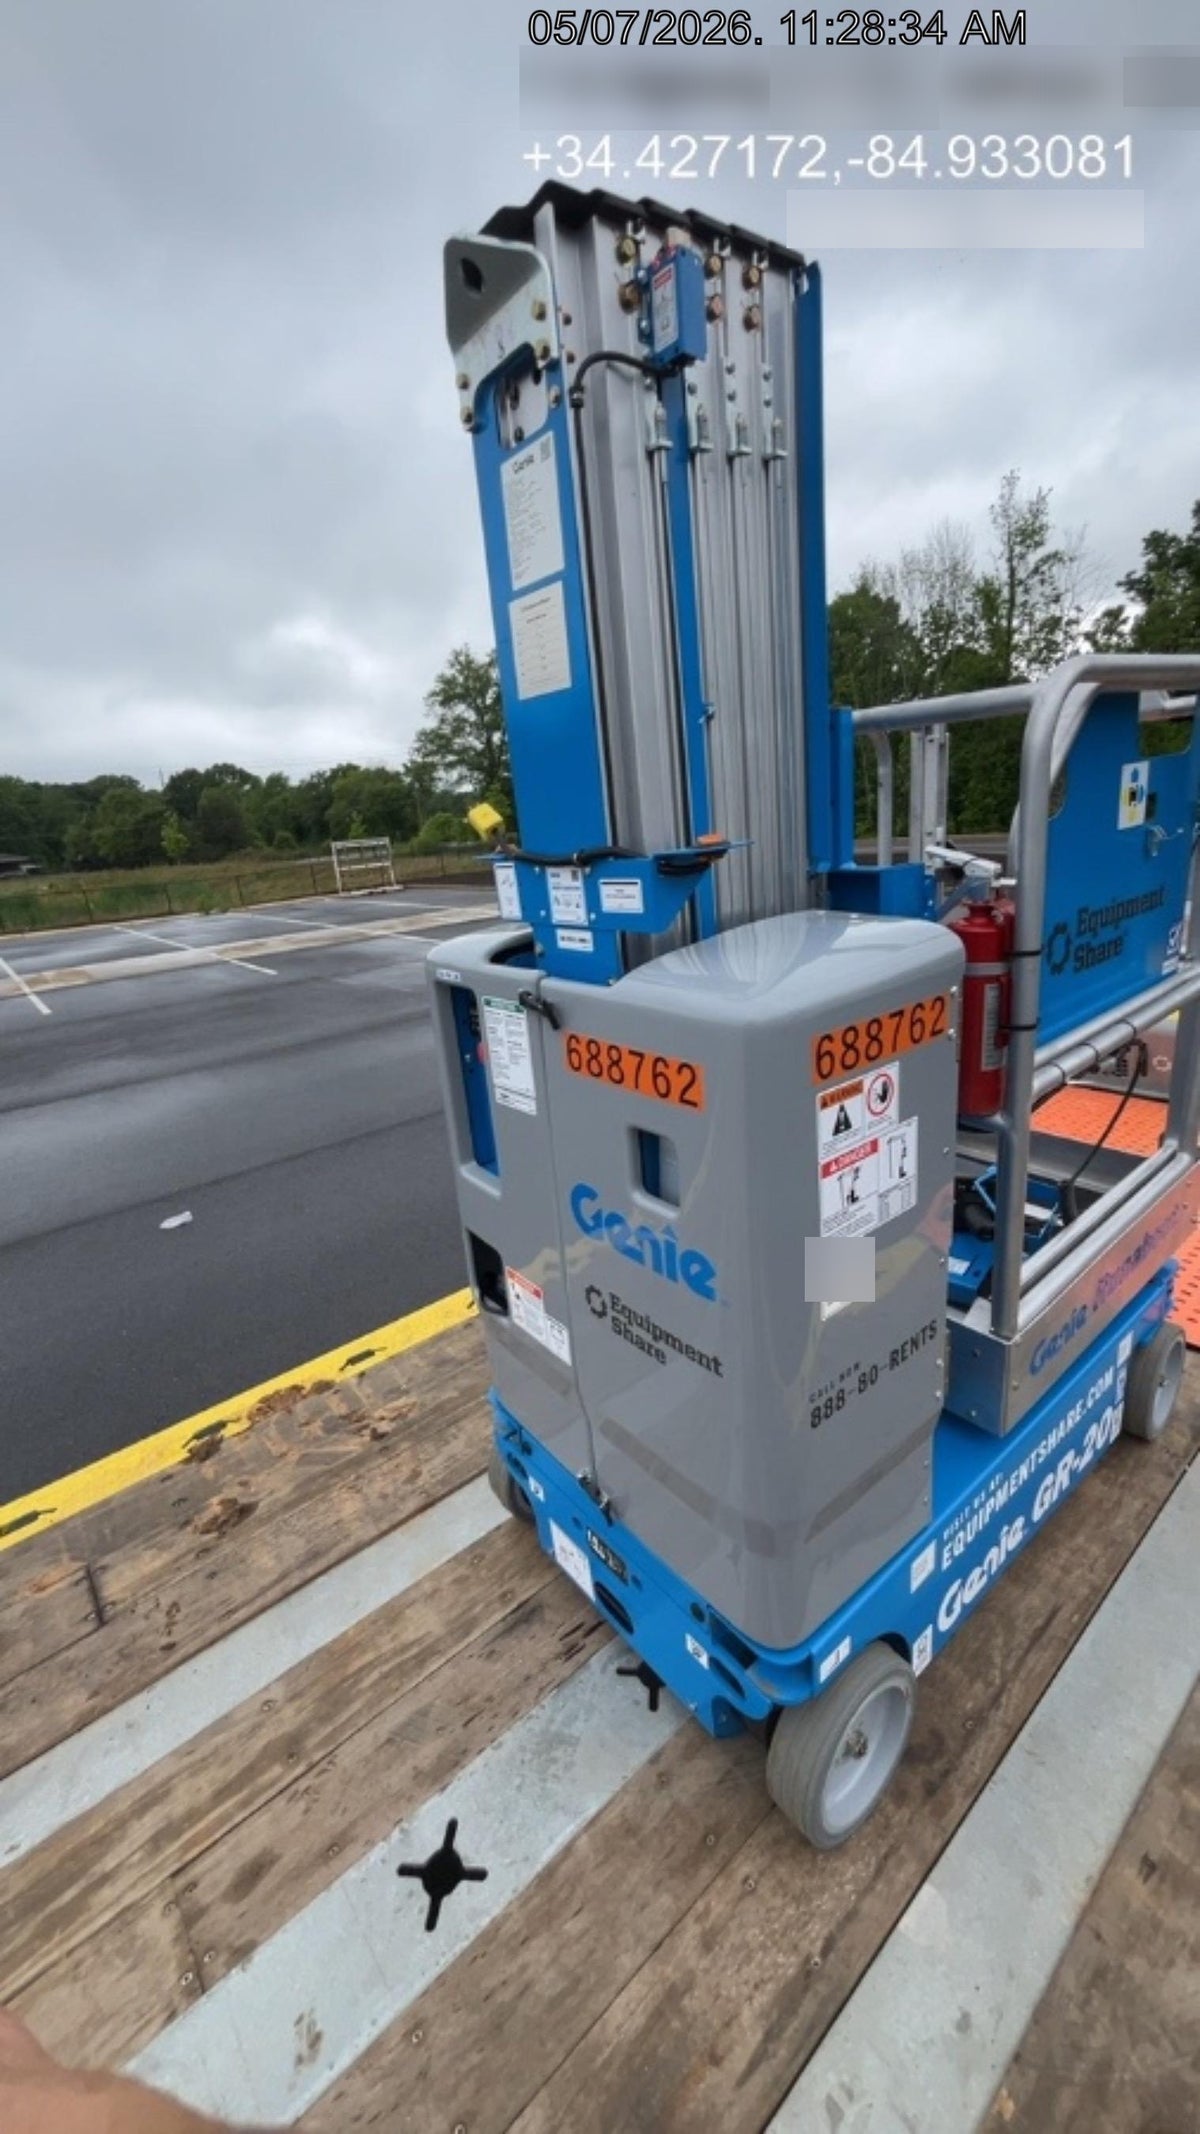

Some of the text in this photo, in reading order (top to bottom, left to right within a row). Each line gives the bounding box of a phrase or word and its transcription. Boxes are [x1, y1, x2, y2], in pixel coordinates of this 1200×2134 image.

[1075, 885, 1165, 937] Equipment
[1073, 934, 1125, 974] Share
[565, 1034, 700, 1108] 688762
[815, 995, 946, 1080] 688762
[570, 1182, 718, 1303] Genie
[608, 1291, 724, 1379] Equipment
[610, 1315, 668, 1366] Share
[810, 1318, 938, 1430] 888-80-RENTS
[1029, 1304, 1089, 1376] Genie
[941, 1366, 1114, 1572] EQUIPMENTSHARE.COM
[937, 1515, 1026, 1632] Genie
